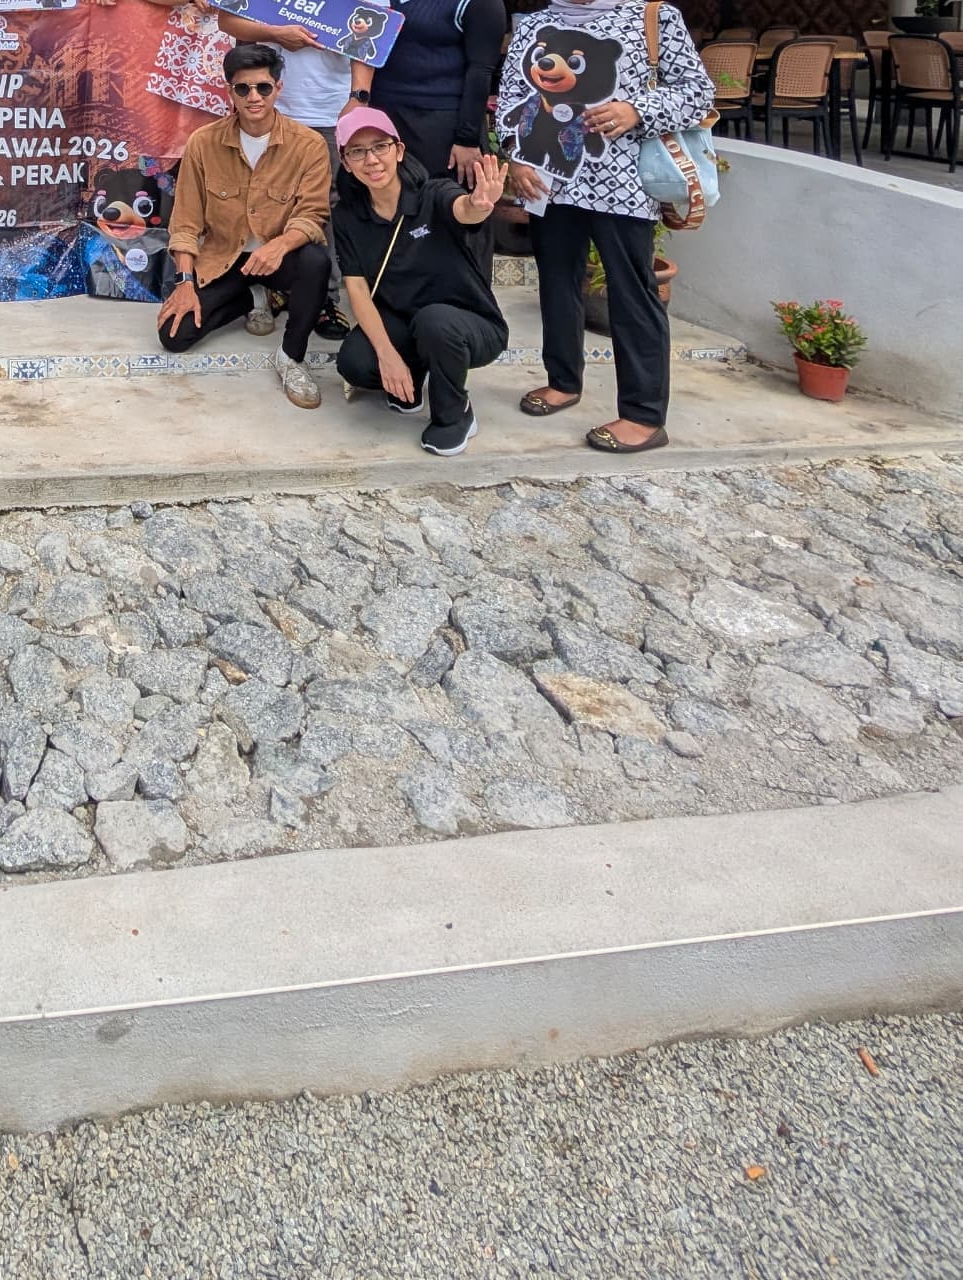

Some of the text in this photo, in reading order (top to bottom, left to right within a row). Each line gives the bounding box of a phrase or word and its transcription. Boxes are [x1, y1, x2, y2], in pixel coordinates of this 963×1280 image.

[278, 7, 342, 37] Experiences!
[67, 136, 129, 162] 2026
[11, 162, 85, 186] PERAK
